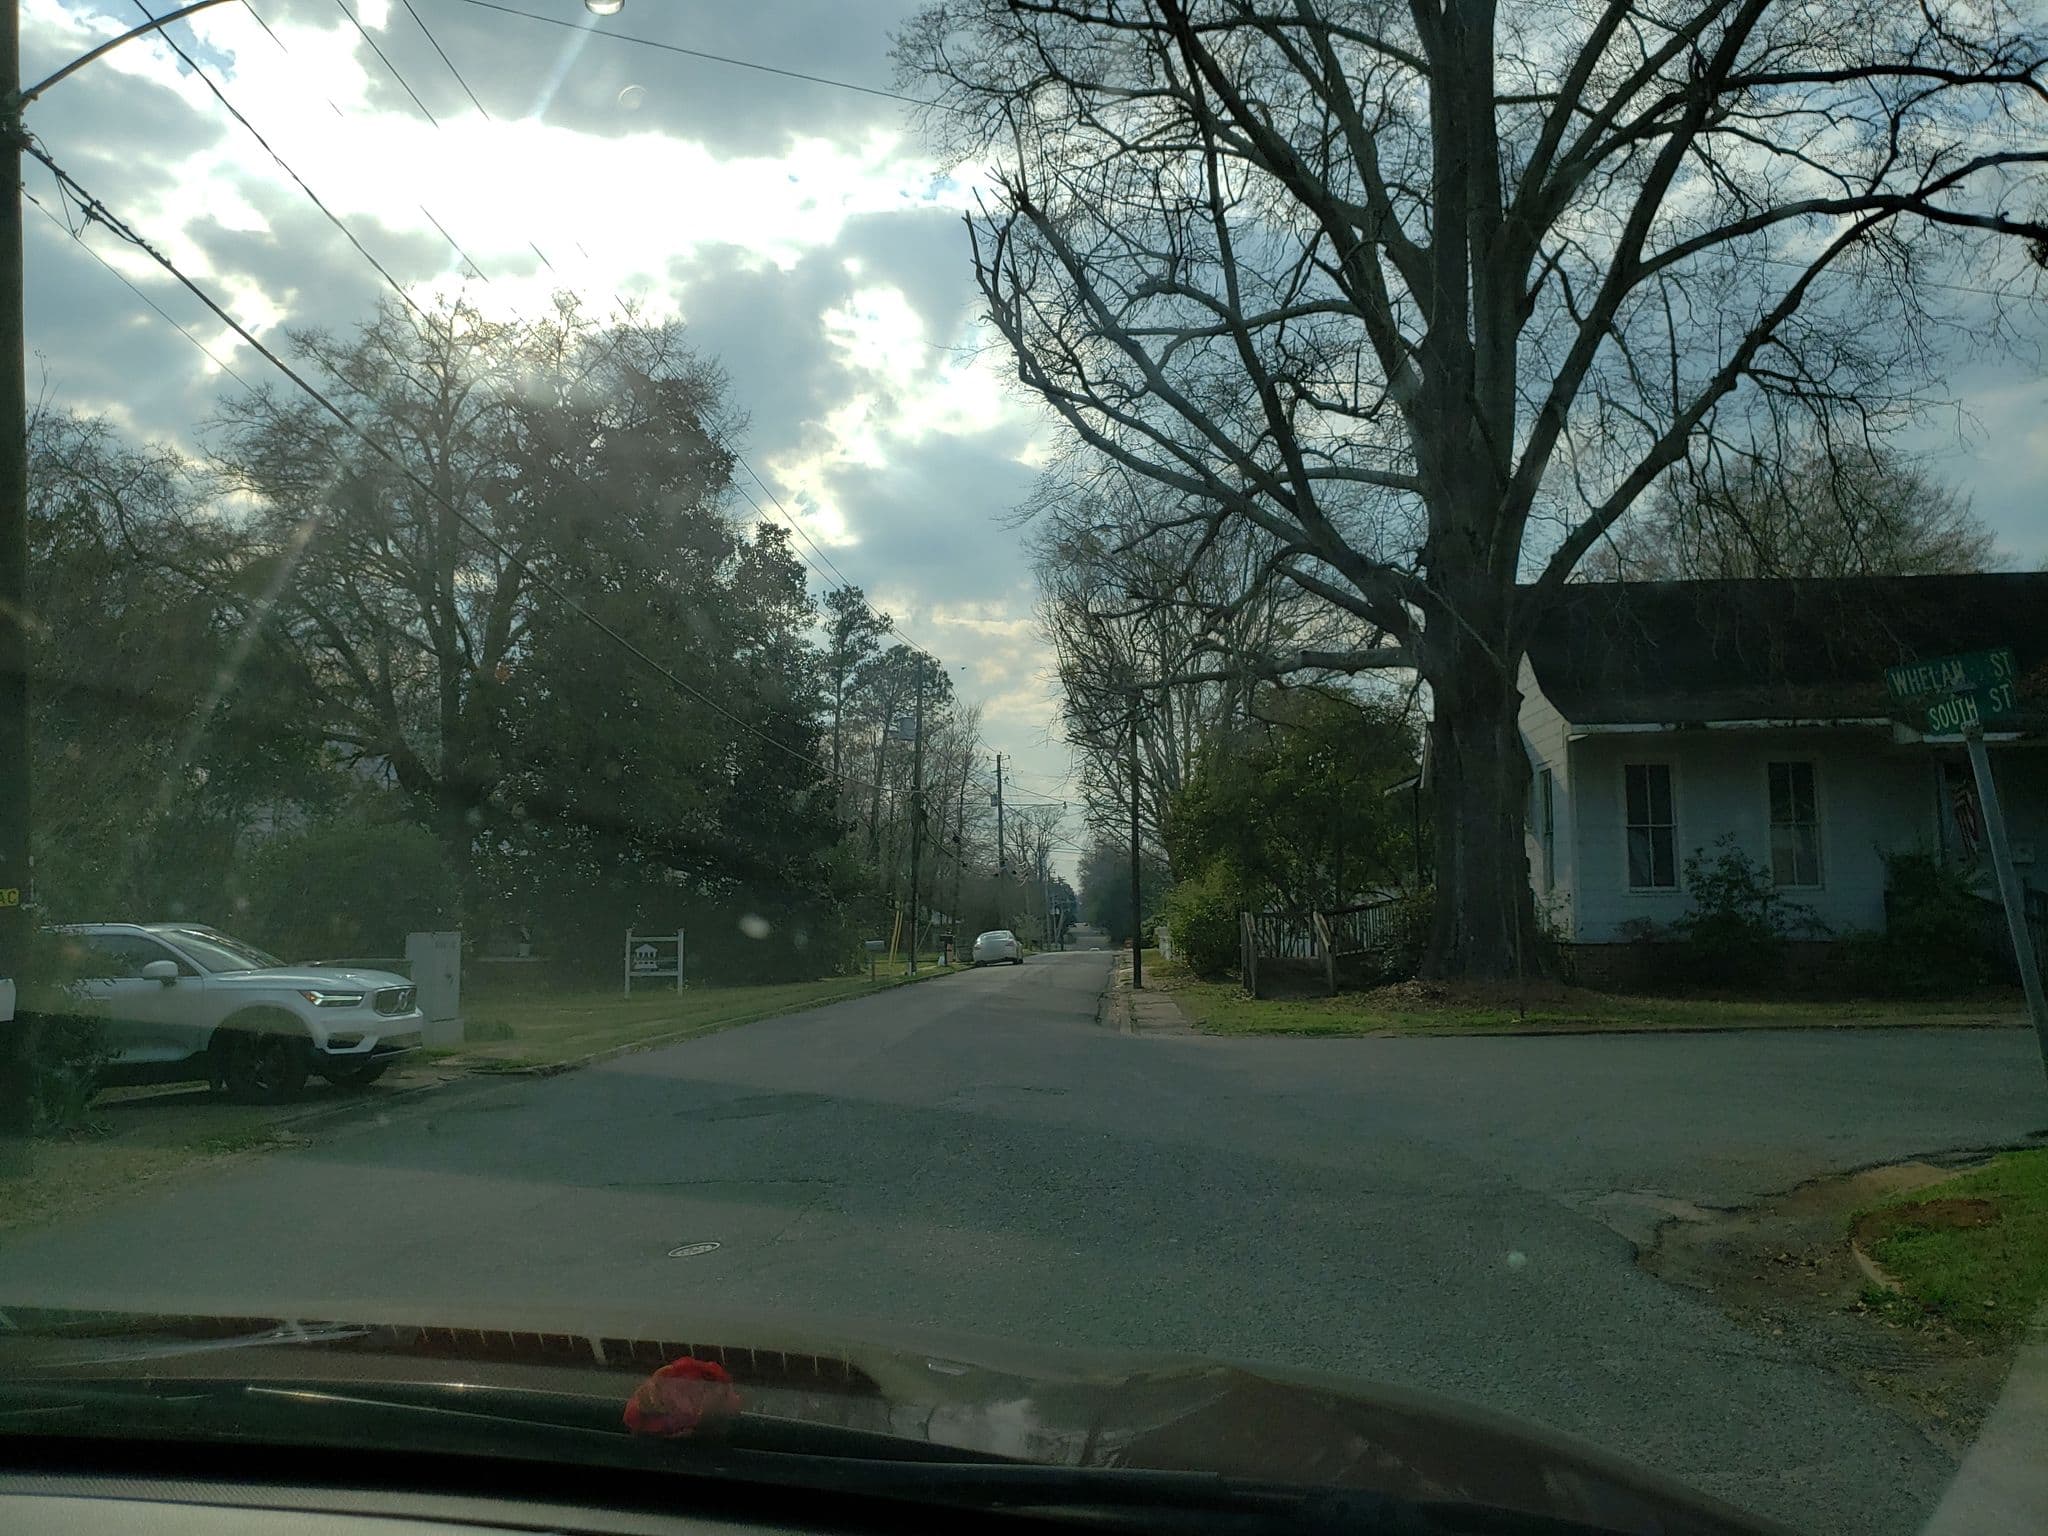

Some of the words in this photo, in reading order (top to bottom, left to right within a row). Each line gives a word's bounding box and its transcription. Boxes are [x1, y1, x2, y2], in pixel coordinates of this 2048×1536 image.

[1890, 660, 1965, 697] WHELAN
[1990, 651, 2012, 678] ST
[1929, 694, 1979, 731] SOUTH
[1990, 683, 2012, 712] ST
